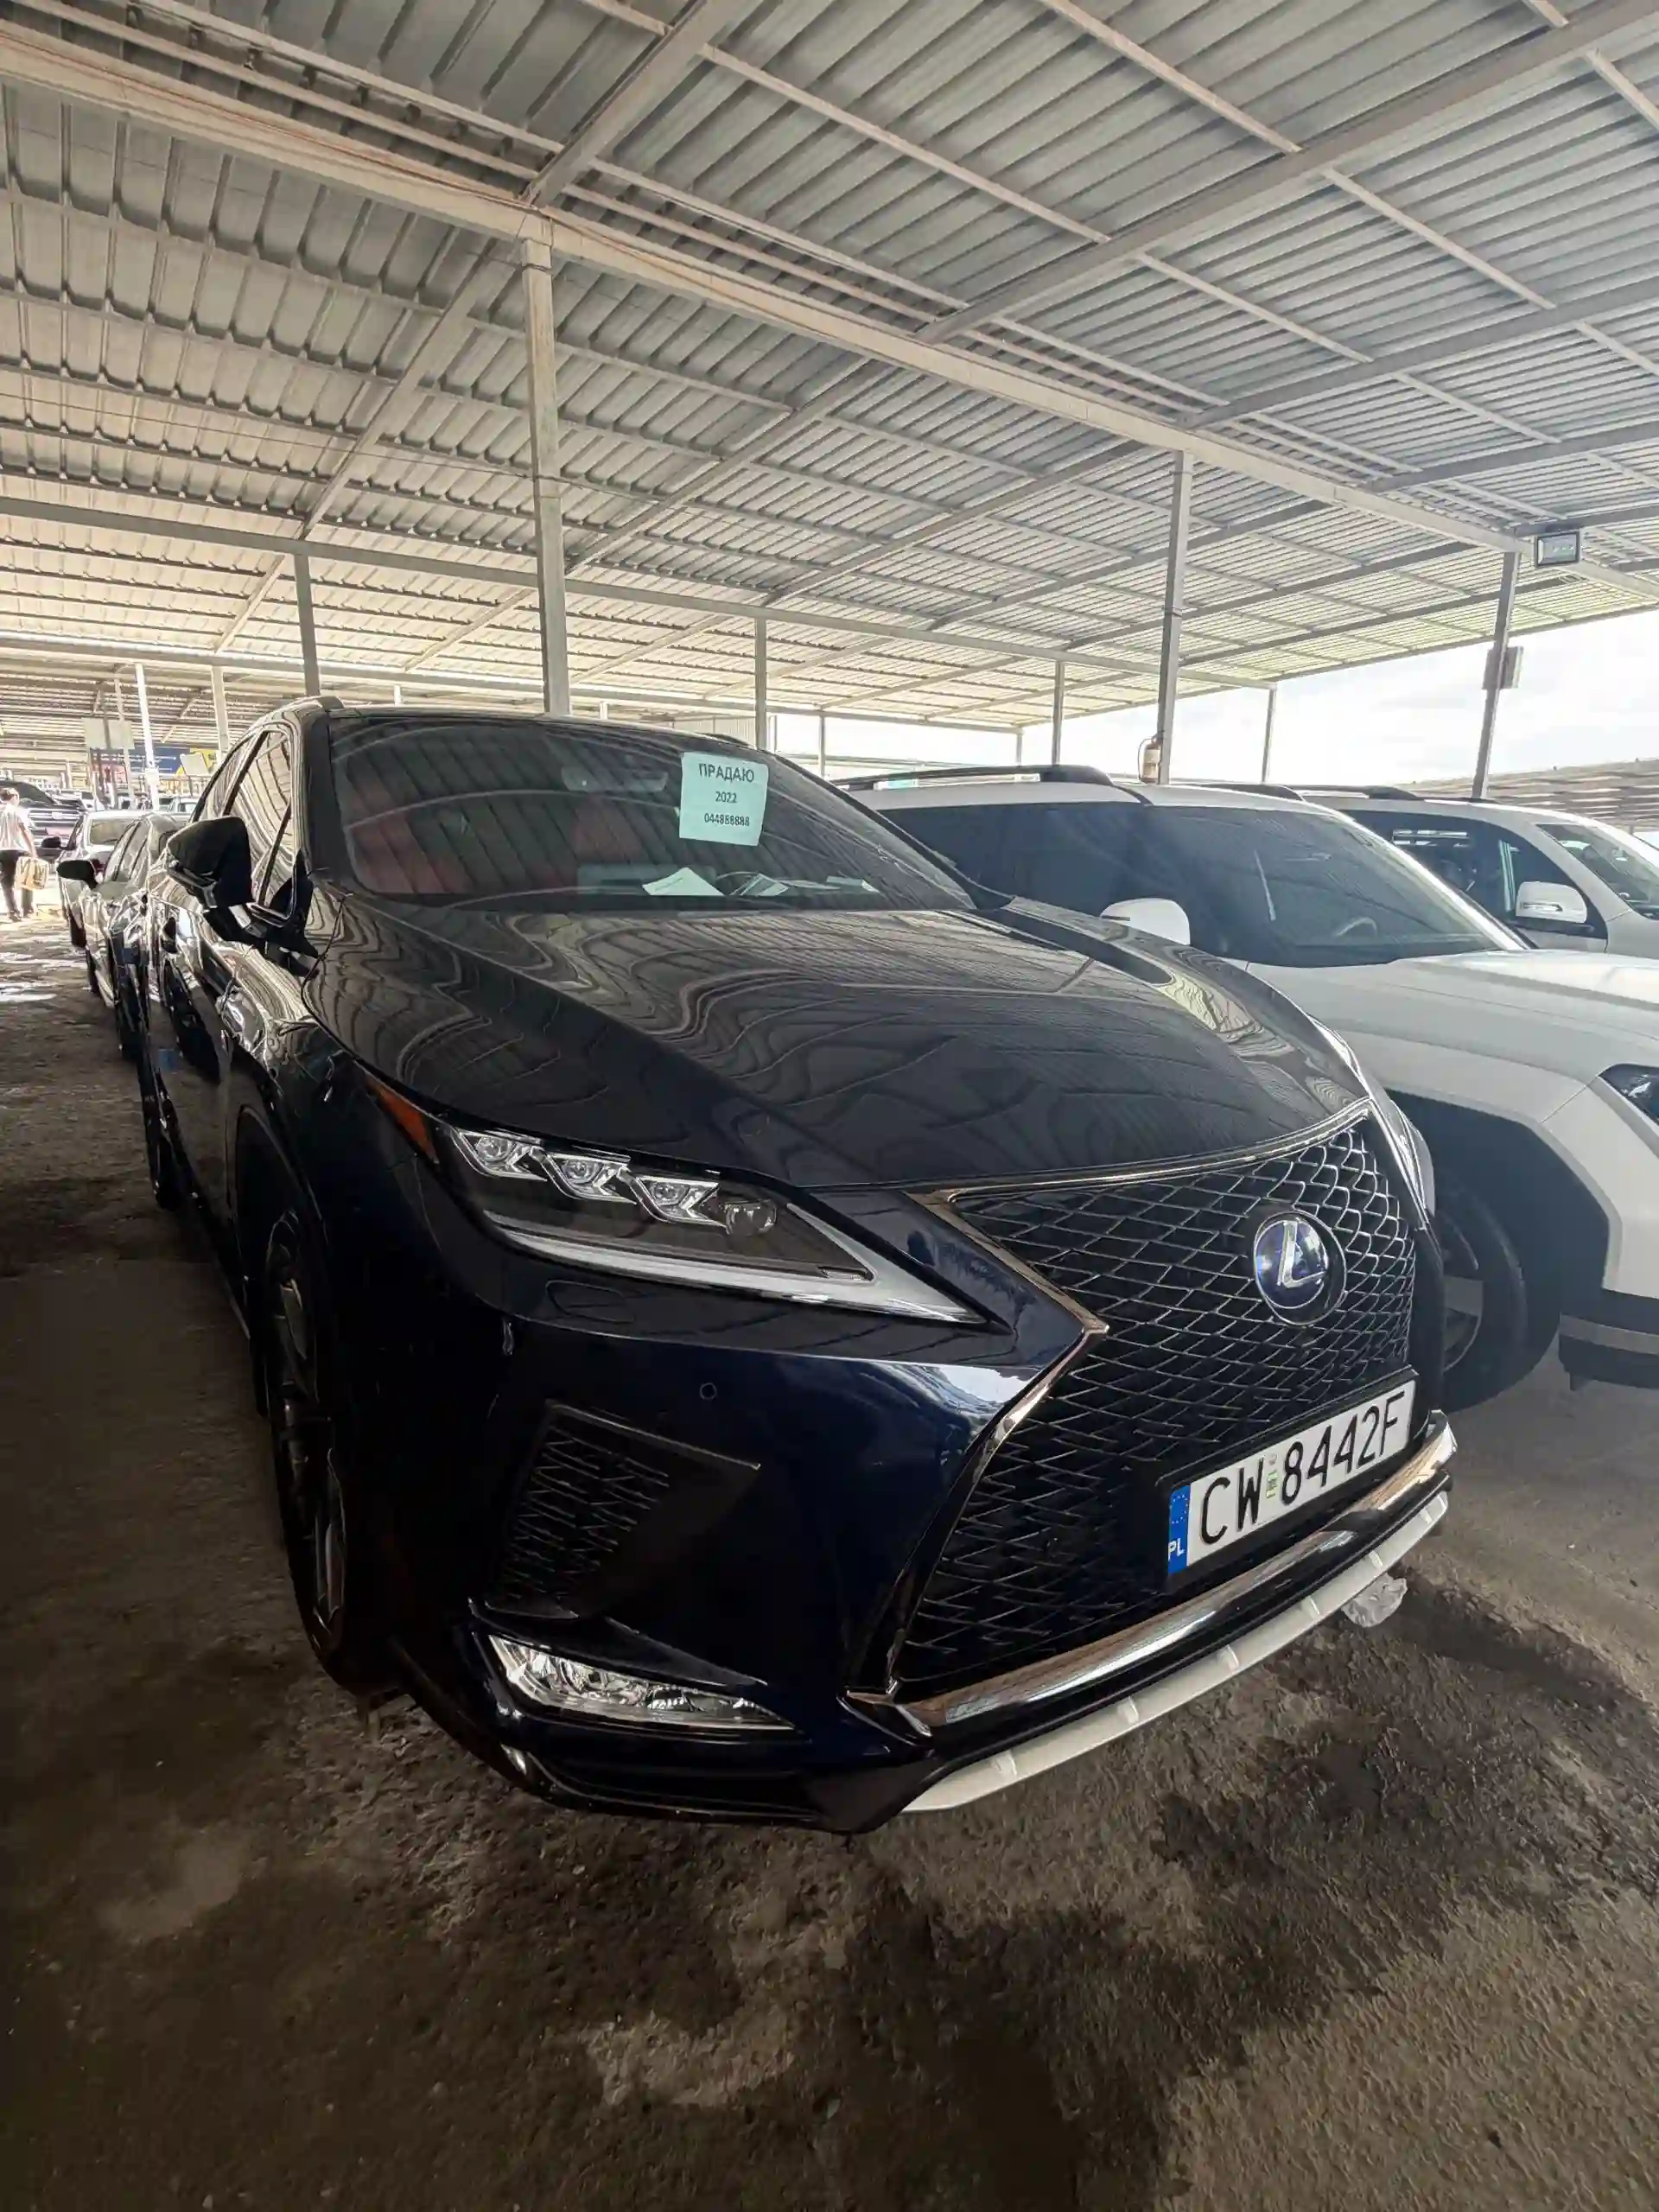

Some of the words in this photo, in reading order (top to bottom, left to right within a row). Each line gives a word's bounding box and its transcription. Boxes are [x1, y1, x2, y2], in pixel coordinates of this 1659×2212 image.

[699, 764, 754, 783] ПРАДАЮ
[715, 791, 737, 804] 2022
[1200, 1459, 1263, 1544] CW
[1281, 1391, 1404, 1505] 8442F
[1168, 1538, 1185, 1560] PL
